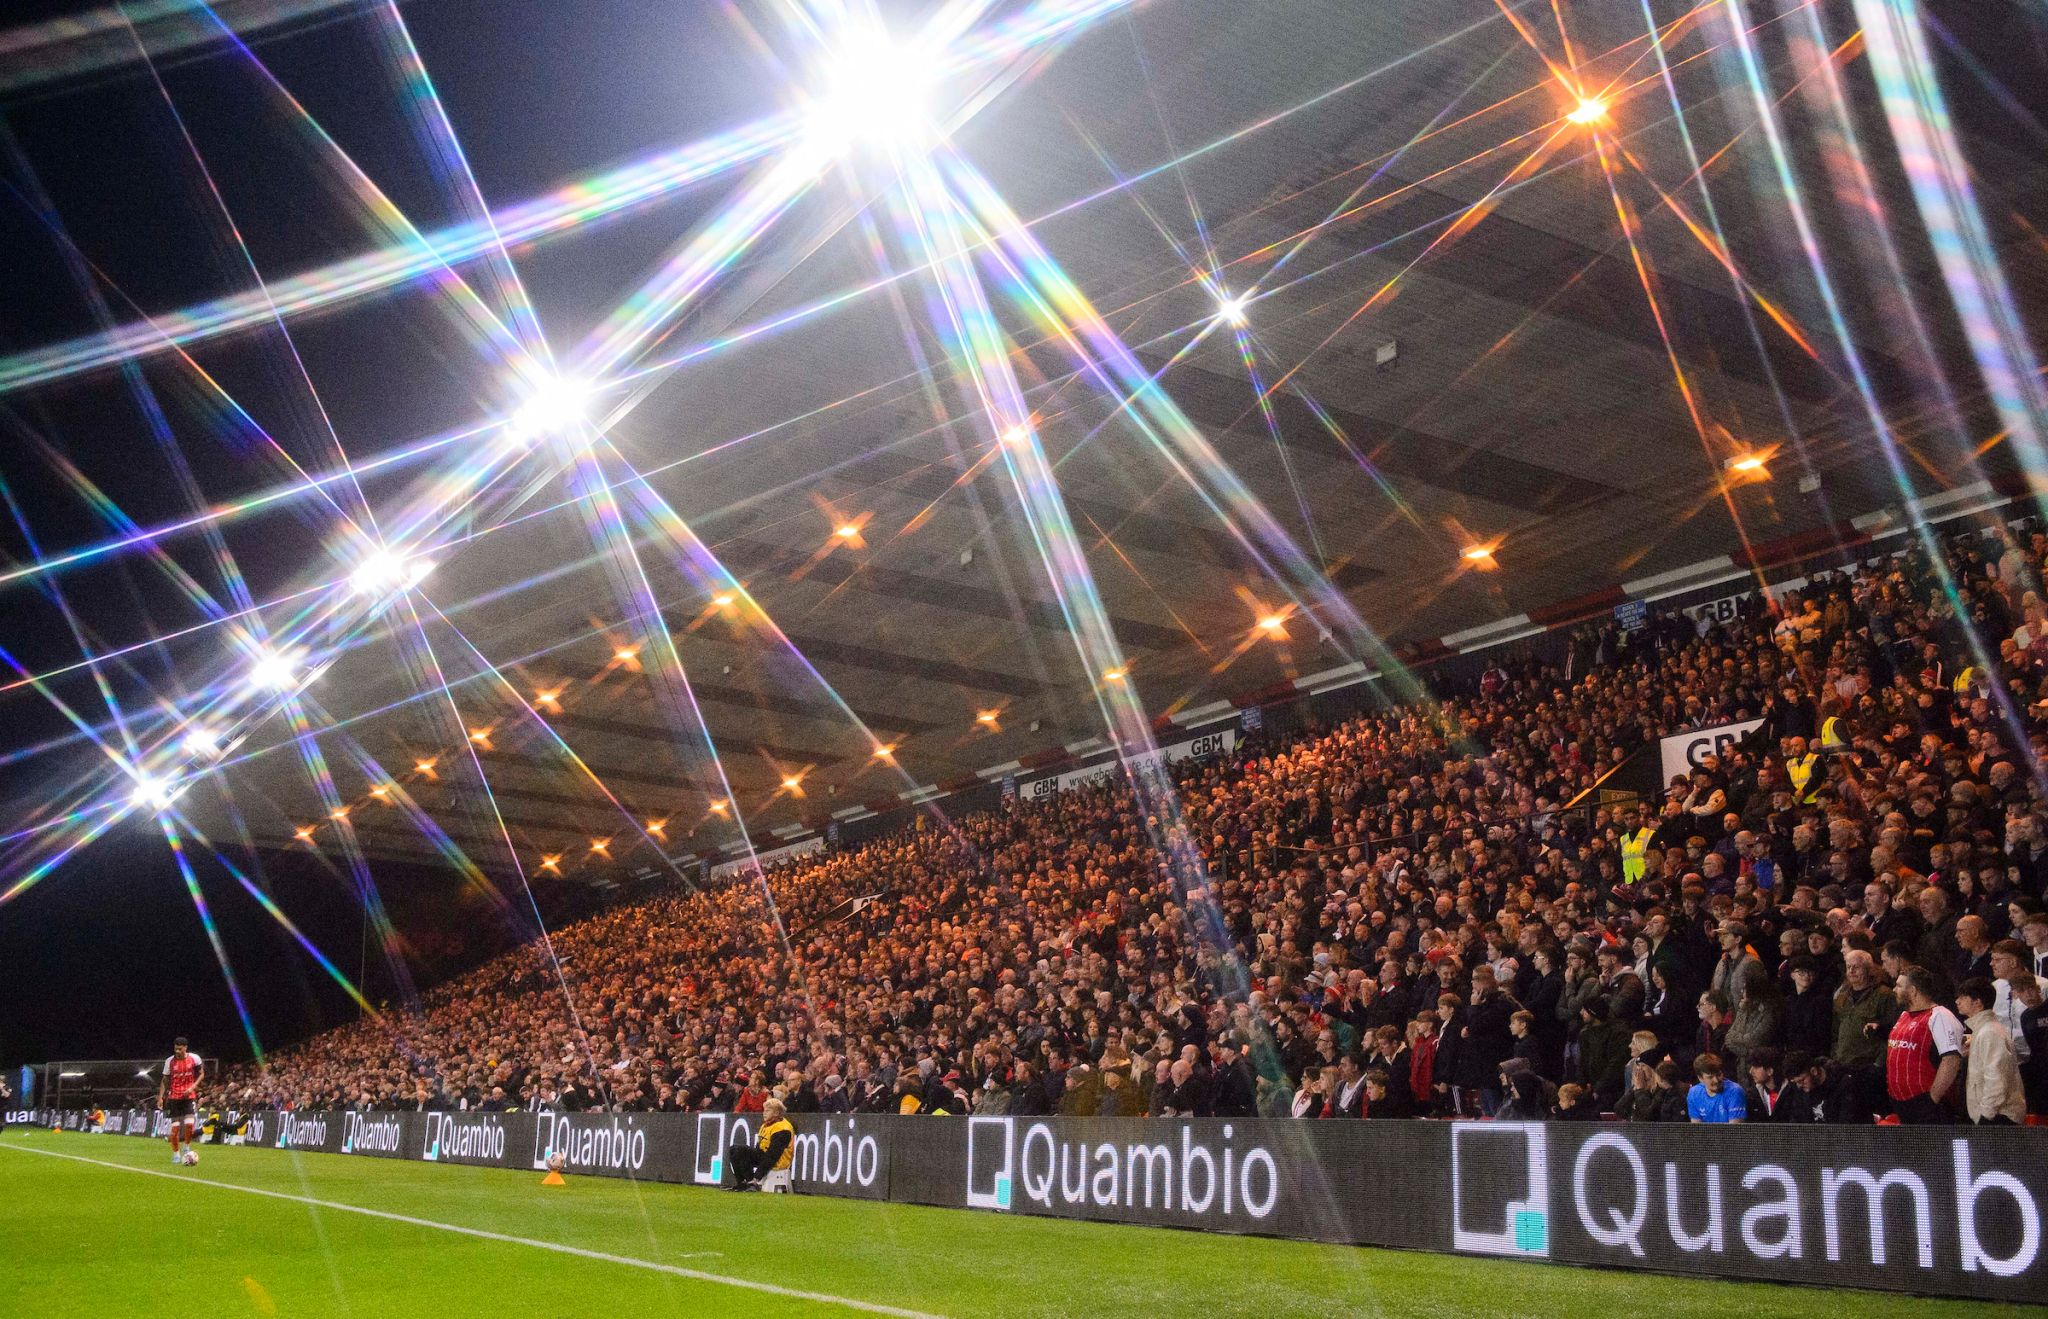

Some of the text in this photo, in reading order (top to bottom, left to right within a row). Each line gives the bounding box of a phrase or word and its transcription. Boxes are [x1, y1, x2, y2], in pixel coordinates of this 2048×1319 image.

[1191, 733, 1222, 756] GBM
[1034, 776, 1058, 796] GBM
[287, 1113, 326, 1146] Quambio
[354, 1114, 400, 1152] Quambio
[441, 1115, 505, 1159] Quambio
[557, 1115, 645, 1170] Quambio
[1022, 1123, 1277, 1218] Quambio
[1573, 1132, 2041, 1277] Quamb
